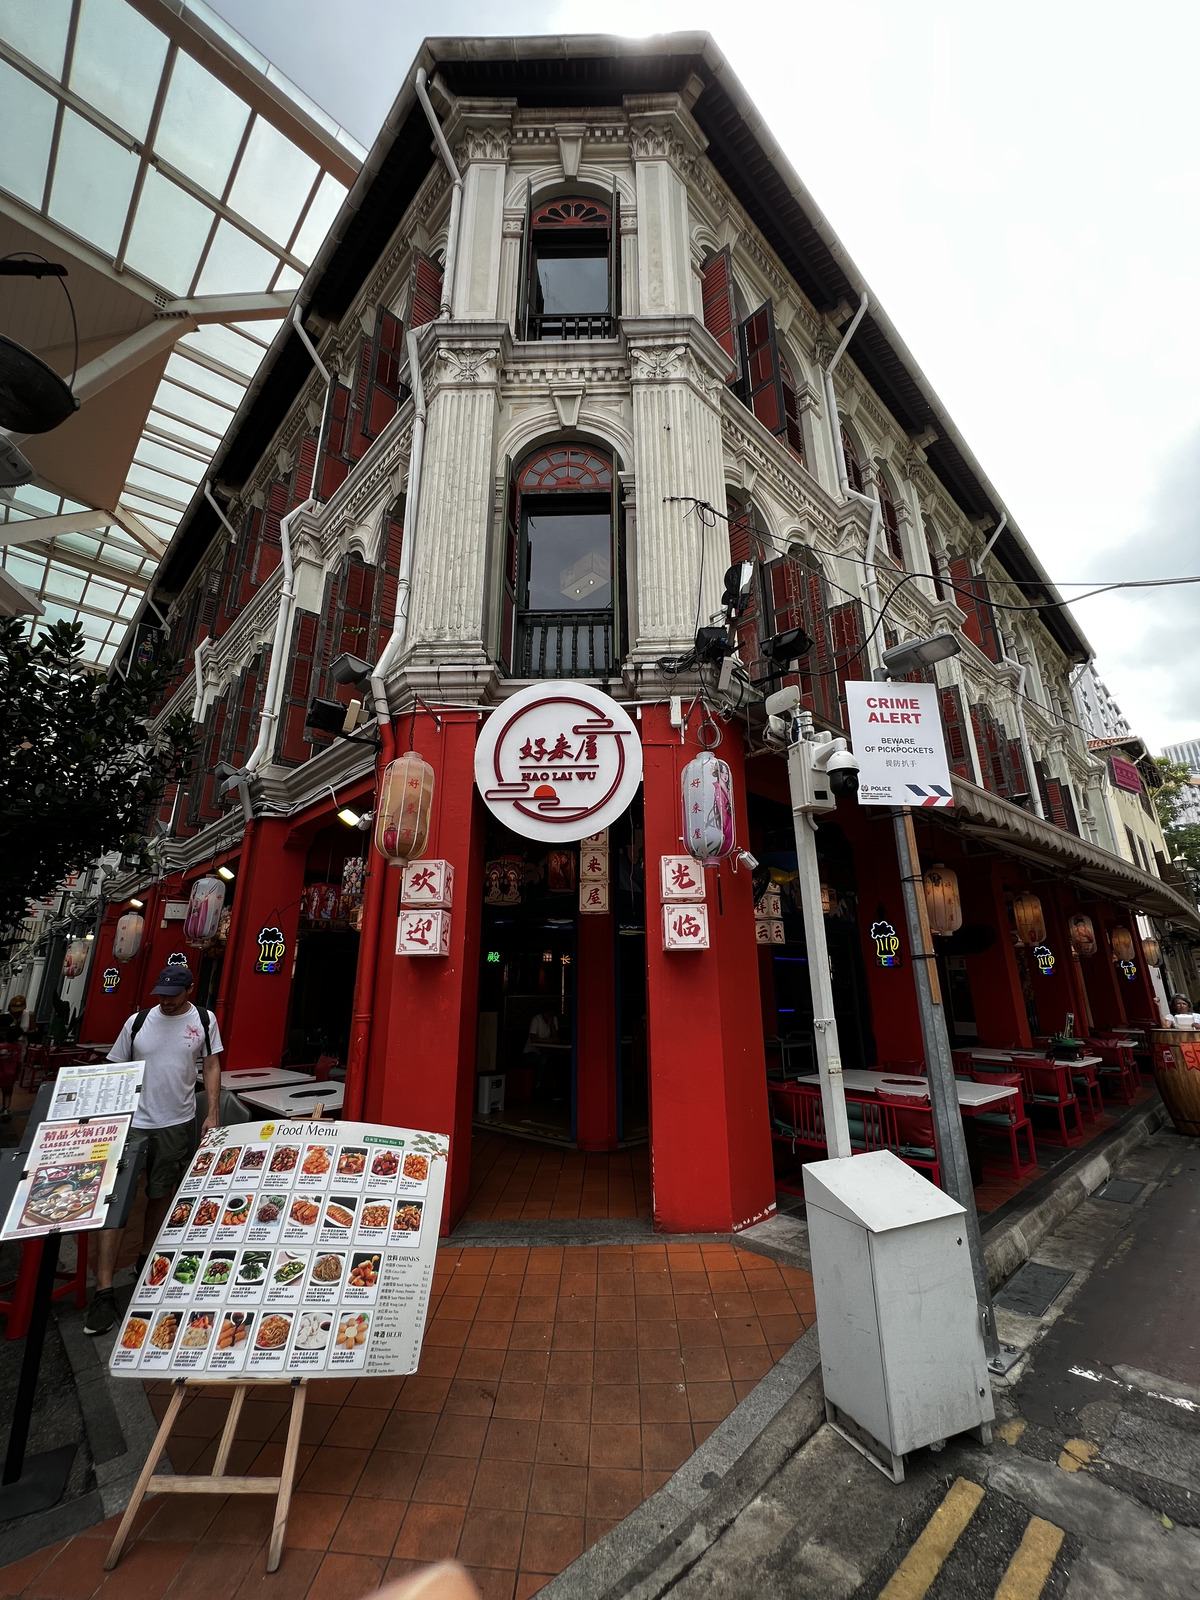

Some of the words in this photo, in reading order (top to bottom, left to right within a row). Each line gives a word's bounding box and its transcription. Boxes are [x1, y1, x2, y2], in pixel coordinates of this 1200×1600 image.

[866, 697, 920, 710] CRIME
[868, 712, 922, 724] ALERT
[519, 733, 598, 762] 好来屋
[864, 745, 876, 753] OF
[878, 746, 934, 754] PICKPOCKETS
[521, 771, 550, 782] HAO
[552, 772, 573, 781] LAI
[575, 771, 597, 781] WU
[277, 1124, 303, 1136] Food
[306, 1124, 339, 1136] Menu
[39, 1141, 71, 1149] CLASSIC
[72, 1135, 118, 1146] STEAMBOAT
